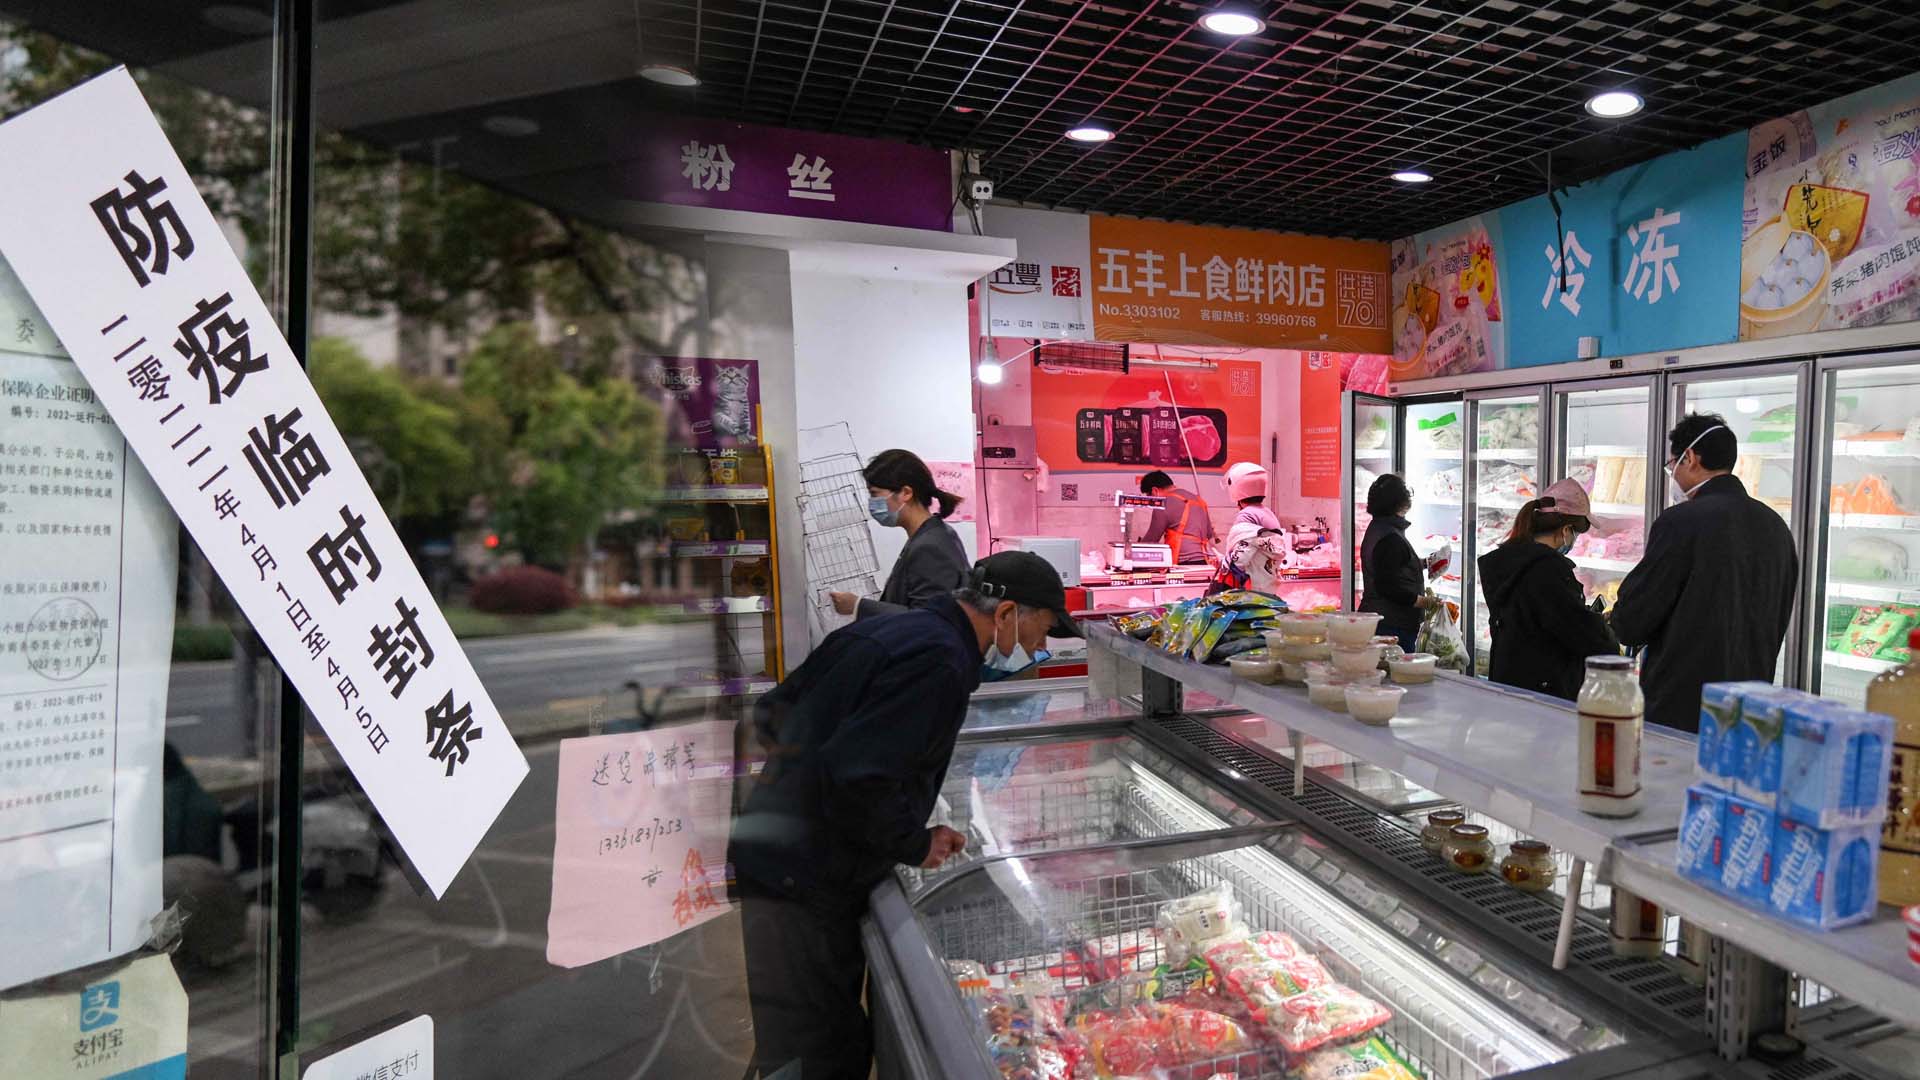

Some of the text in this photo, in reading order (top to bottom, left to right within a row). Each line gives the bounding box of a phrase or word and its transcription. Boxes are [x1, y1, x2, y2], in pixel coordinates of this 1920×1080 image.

[680, 140, 836, 202] 粉丝
[1098, 247, 1327, 308] 五丰上食鲜肉店
[1541, 207, 1683, 318] 冷冻
[1100, 303, 1181, 321] No.3303102
[1339, 299, 1376, 325] 70
[89, 169, 485, 777] 防疫临时封条
[72, 1028, 123, 1060] 支付宝
